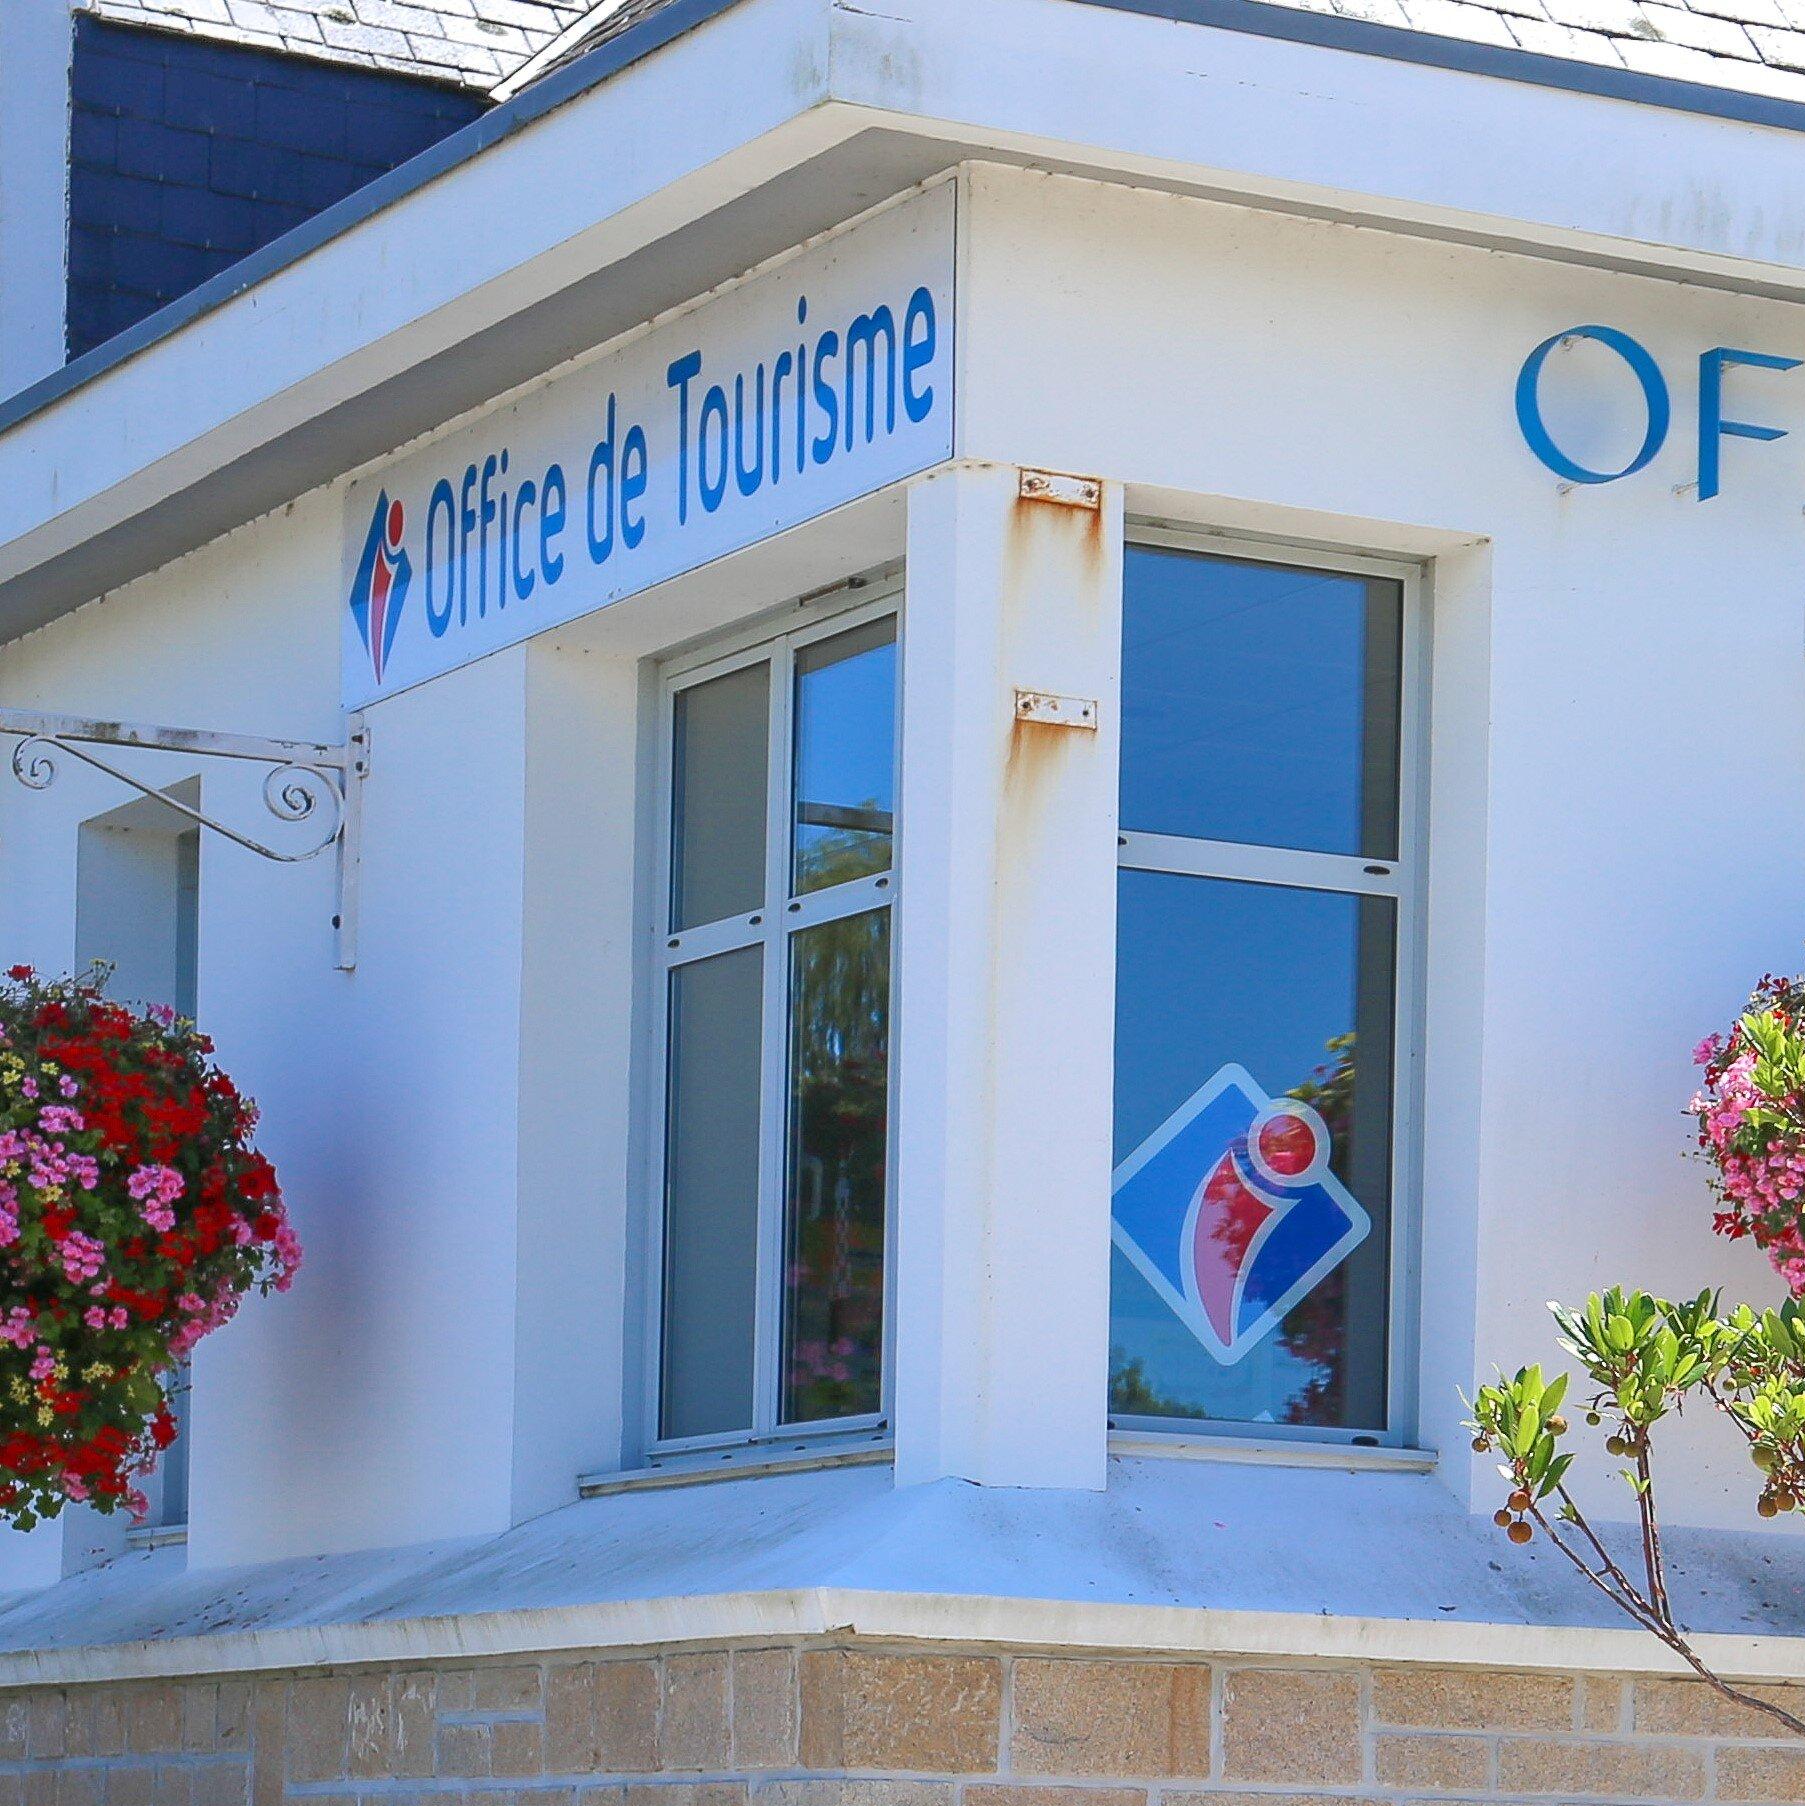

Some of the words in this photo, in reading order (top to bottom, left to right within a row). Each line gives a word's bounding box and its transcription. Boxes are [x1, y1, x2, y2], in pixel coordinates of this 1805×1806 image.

[425, 447, 566, 639] Office
[587, 392, 648, 565] de
[666, 286, 937, 526] Tourisme
